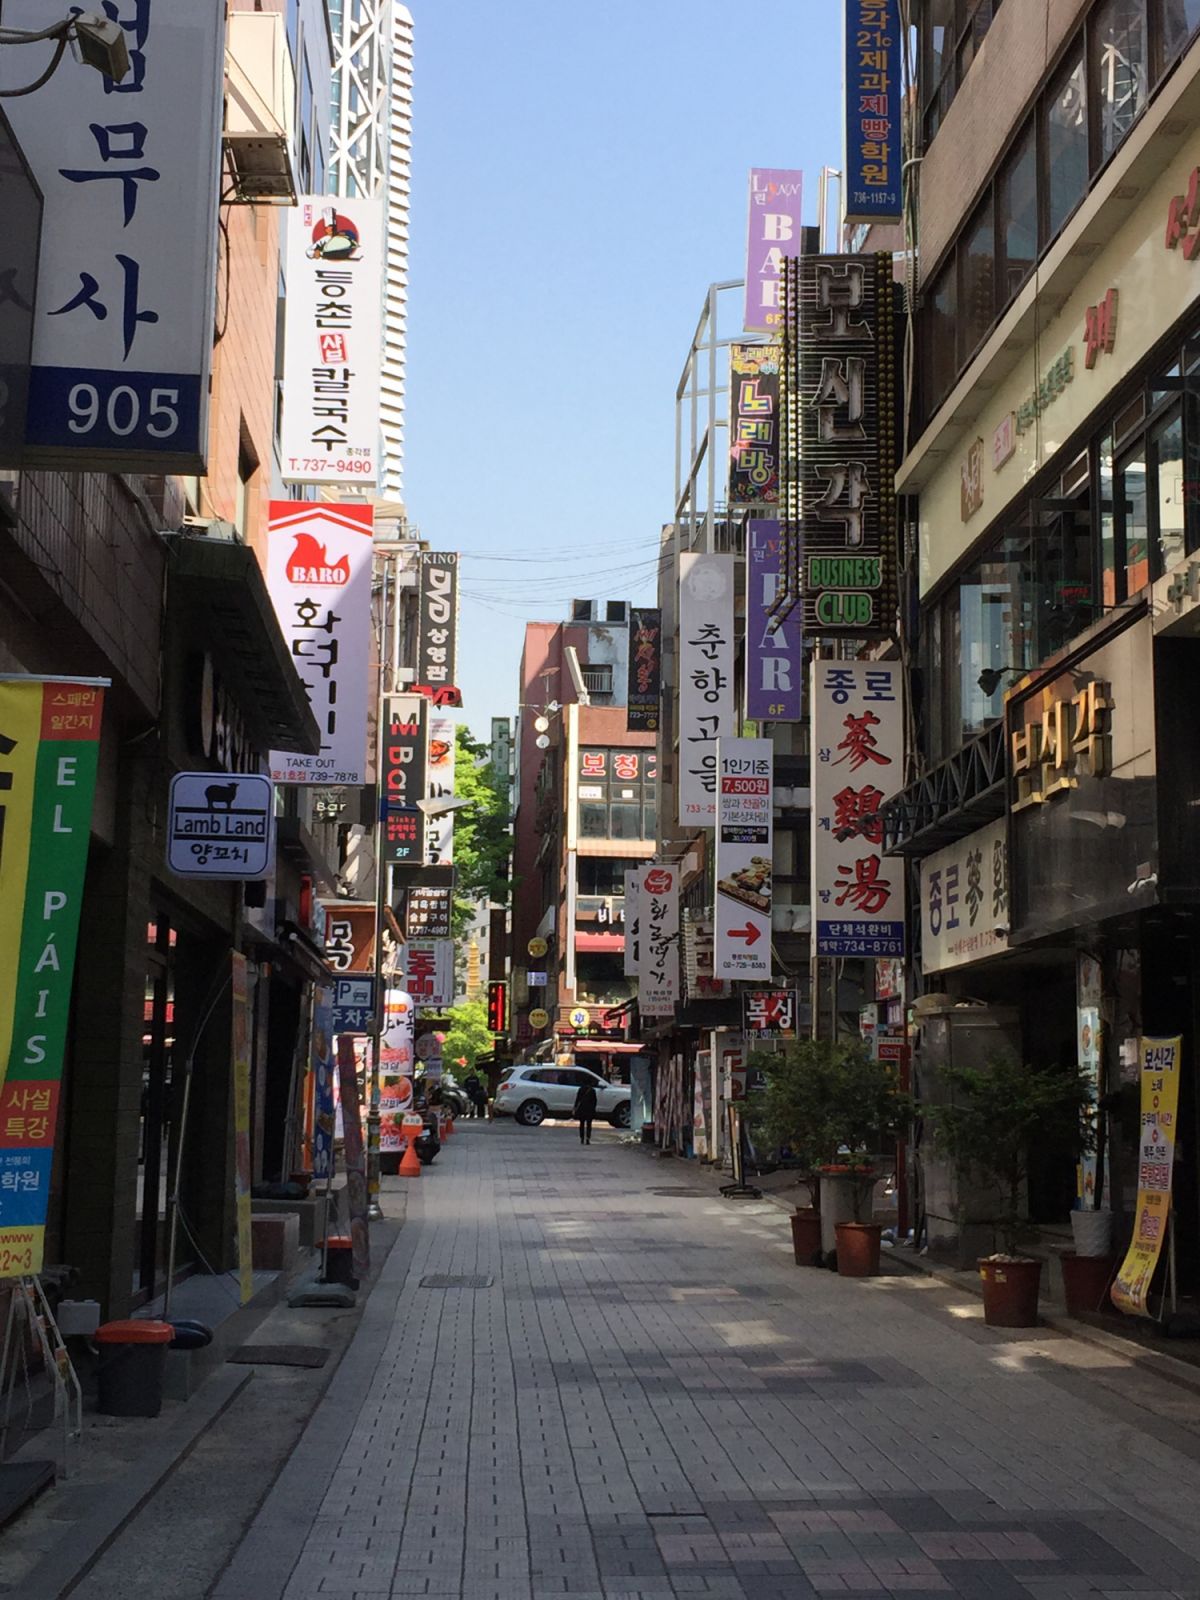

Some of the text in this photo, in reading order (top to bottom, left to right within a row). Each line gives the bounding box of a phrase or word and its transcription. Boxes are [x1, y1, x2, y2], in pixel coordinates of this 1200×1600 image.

[68, 382, 179, 437] 905
[811, 263, 876, 553] 보신각
[739, 380, 773, 485] 노래방
[288, 458, 372, 473] T.737-9490
[422, 553, 456, 564] KINO
[291, 567, 346, 583] BARO
[811, 558, 882, 588] BUSINESS
[426, 567, 451, 624] DVD
[817, 593, 872, 624] CLUB
[758, 573, 793, 692] BAR
[292, 598, 342, 750] 화덕치
[824, 669, 895, 704] 종로
[51, 692, 96, 707] 스페인
[768, 704, 785, 715] 6F
[51, 715, 94, 730] 일간지
[391, 712, 417, 736] M
[285, 758, 336, 768] TAKE OUT
[722, 758, 770, 775] 1인기준
[309, 771, 358, 782] 739-7878
[316, 802, 347, 811] Bar
[175, 814, 265, 835] Lamb Land
[191, 843, 248, 865] 양꼬치
[396, 847, 410, 857] 2F
[929, 864, 959, 936] 종로
[829, 924, 891, 937] 단체석완비
[340, 982, 351, 998] P
[746, 998, 792, 1029] 복싱
[1144, 1047, 1175, 1071] 보신각
[6, 1088, 51, 1111] 사설
[5, 1117, 49, 1139] 특강
[2, 1170, 40, 1192] 학원
